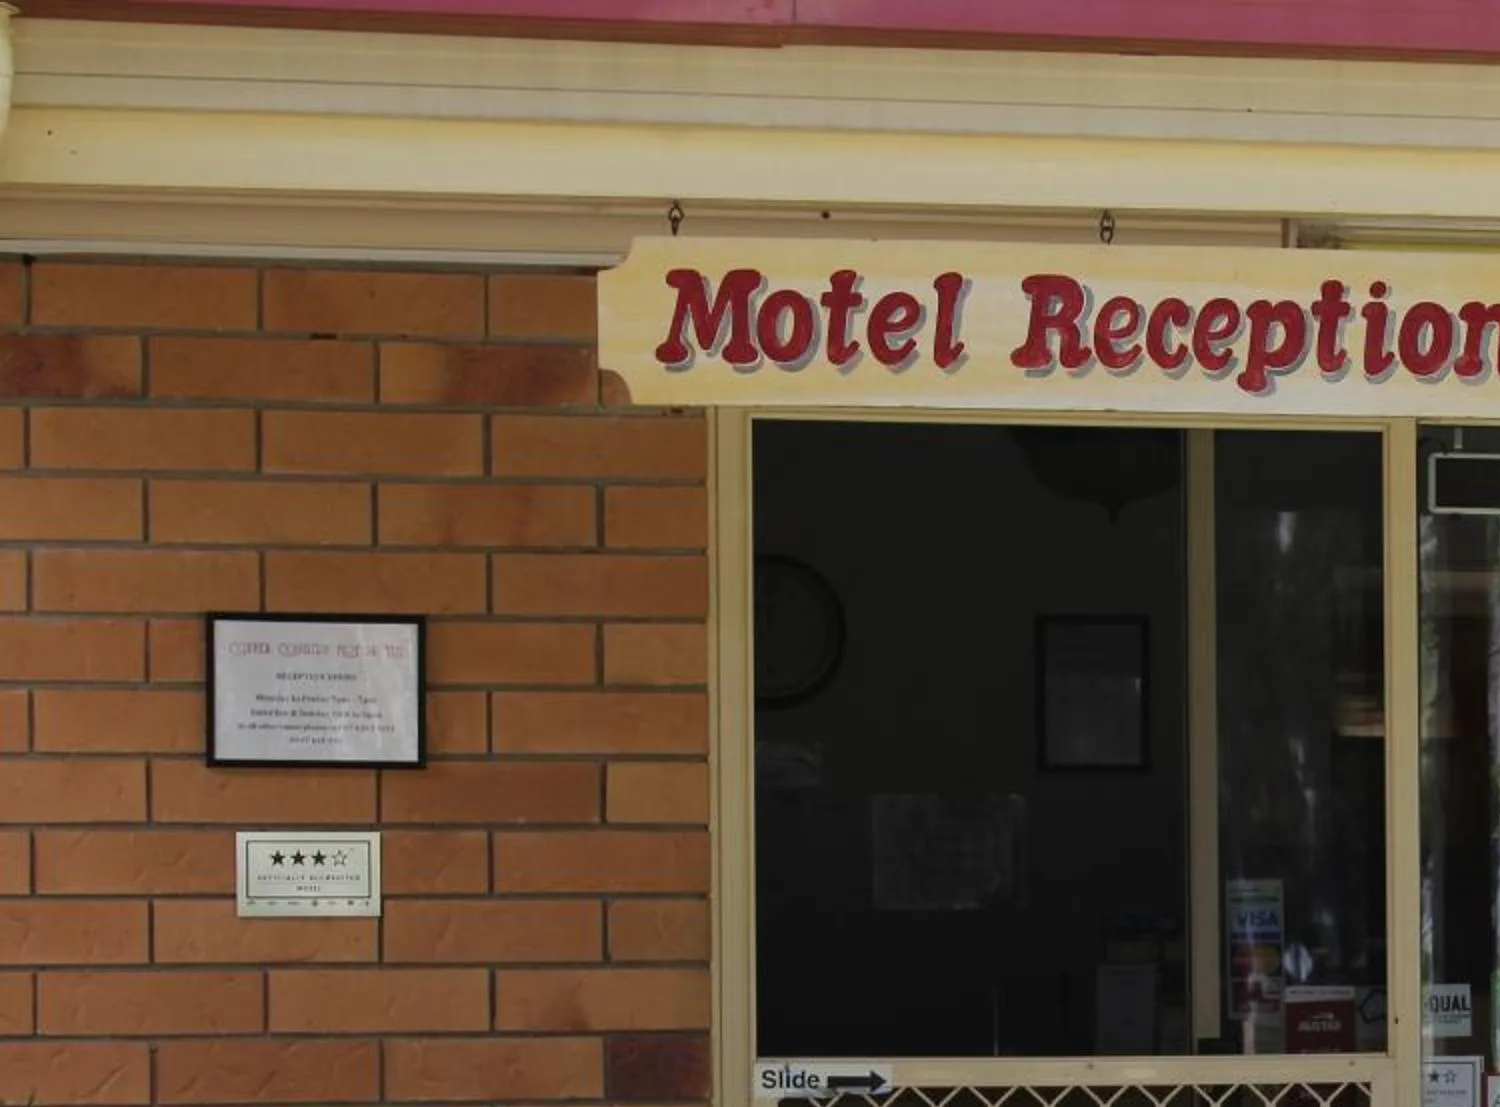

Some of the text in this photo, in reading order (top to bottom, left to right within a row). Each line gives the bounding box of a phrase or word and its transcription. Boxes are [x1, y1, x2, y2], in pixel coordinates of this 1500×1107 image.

[655, 267, 966, 370] Motel
[1237, 911, 1279, 927] VISA
[761, 1067, 820, 1089] Slide
